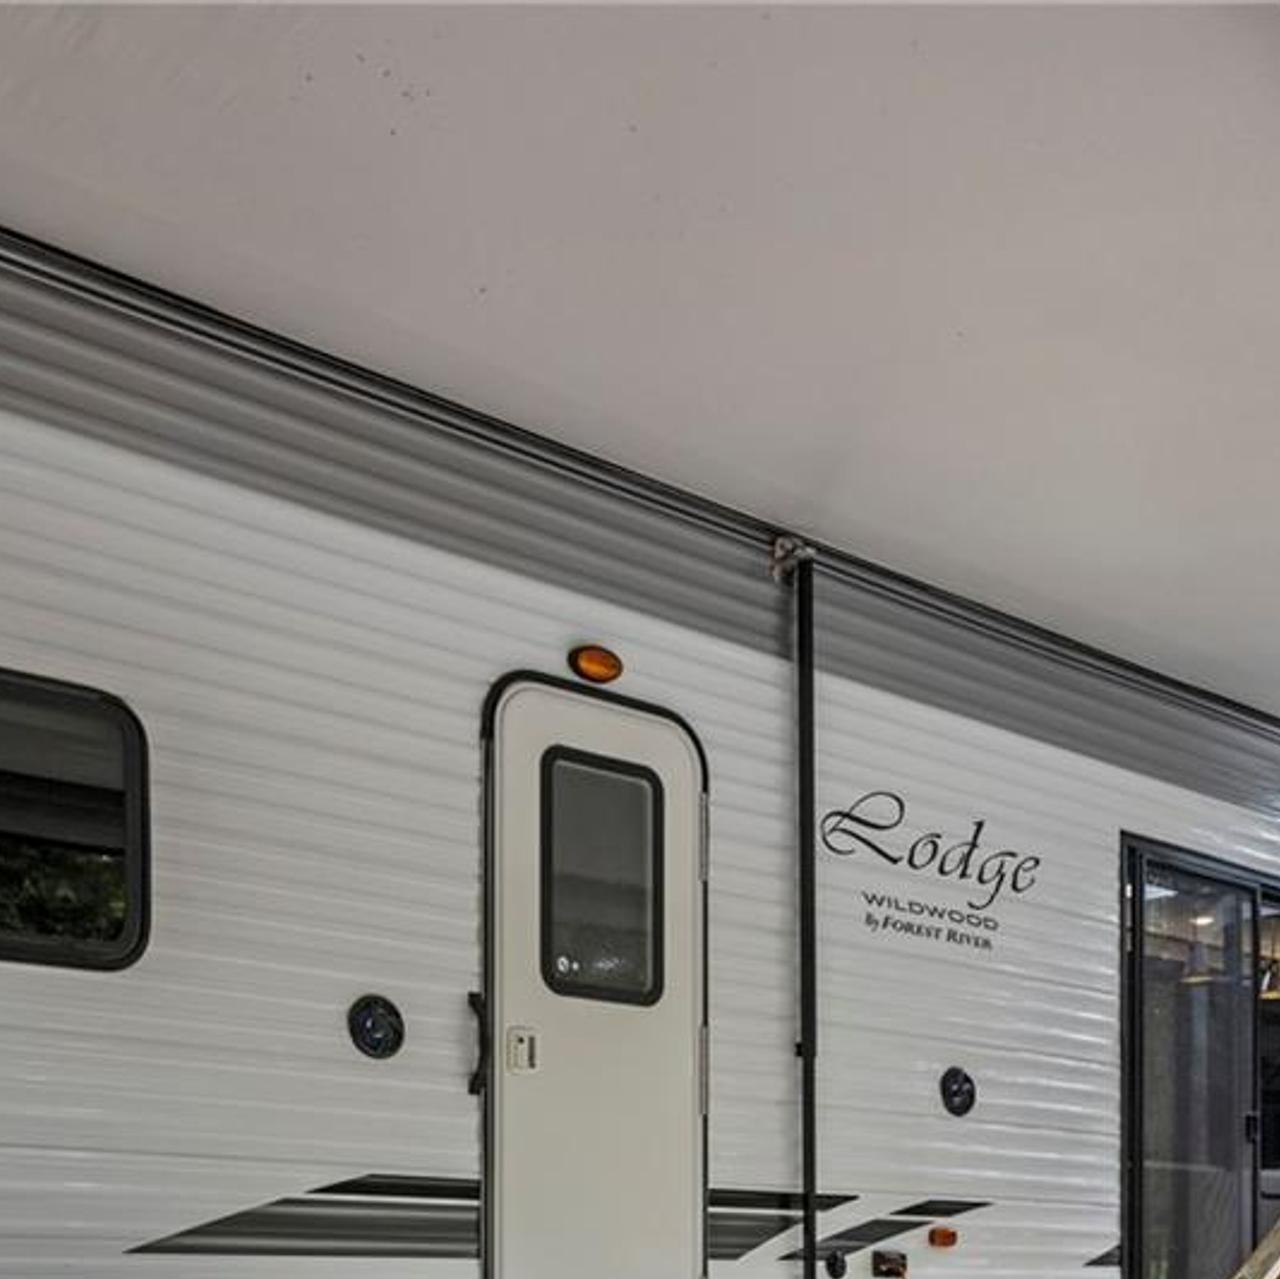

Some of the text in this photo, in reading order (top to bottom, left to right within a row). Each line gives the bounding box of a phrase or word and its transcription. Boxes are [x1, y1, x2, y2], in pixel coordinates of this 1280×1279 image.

[819, 791, 1041, 911] Lodge
[861, 890, 999, 931] WILDWOOD
[881, 914, 943, 941] FOREST
[946, 928, 993, 950] RIVER
